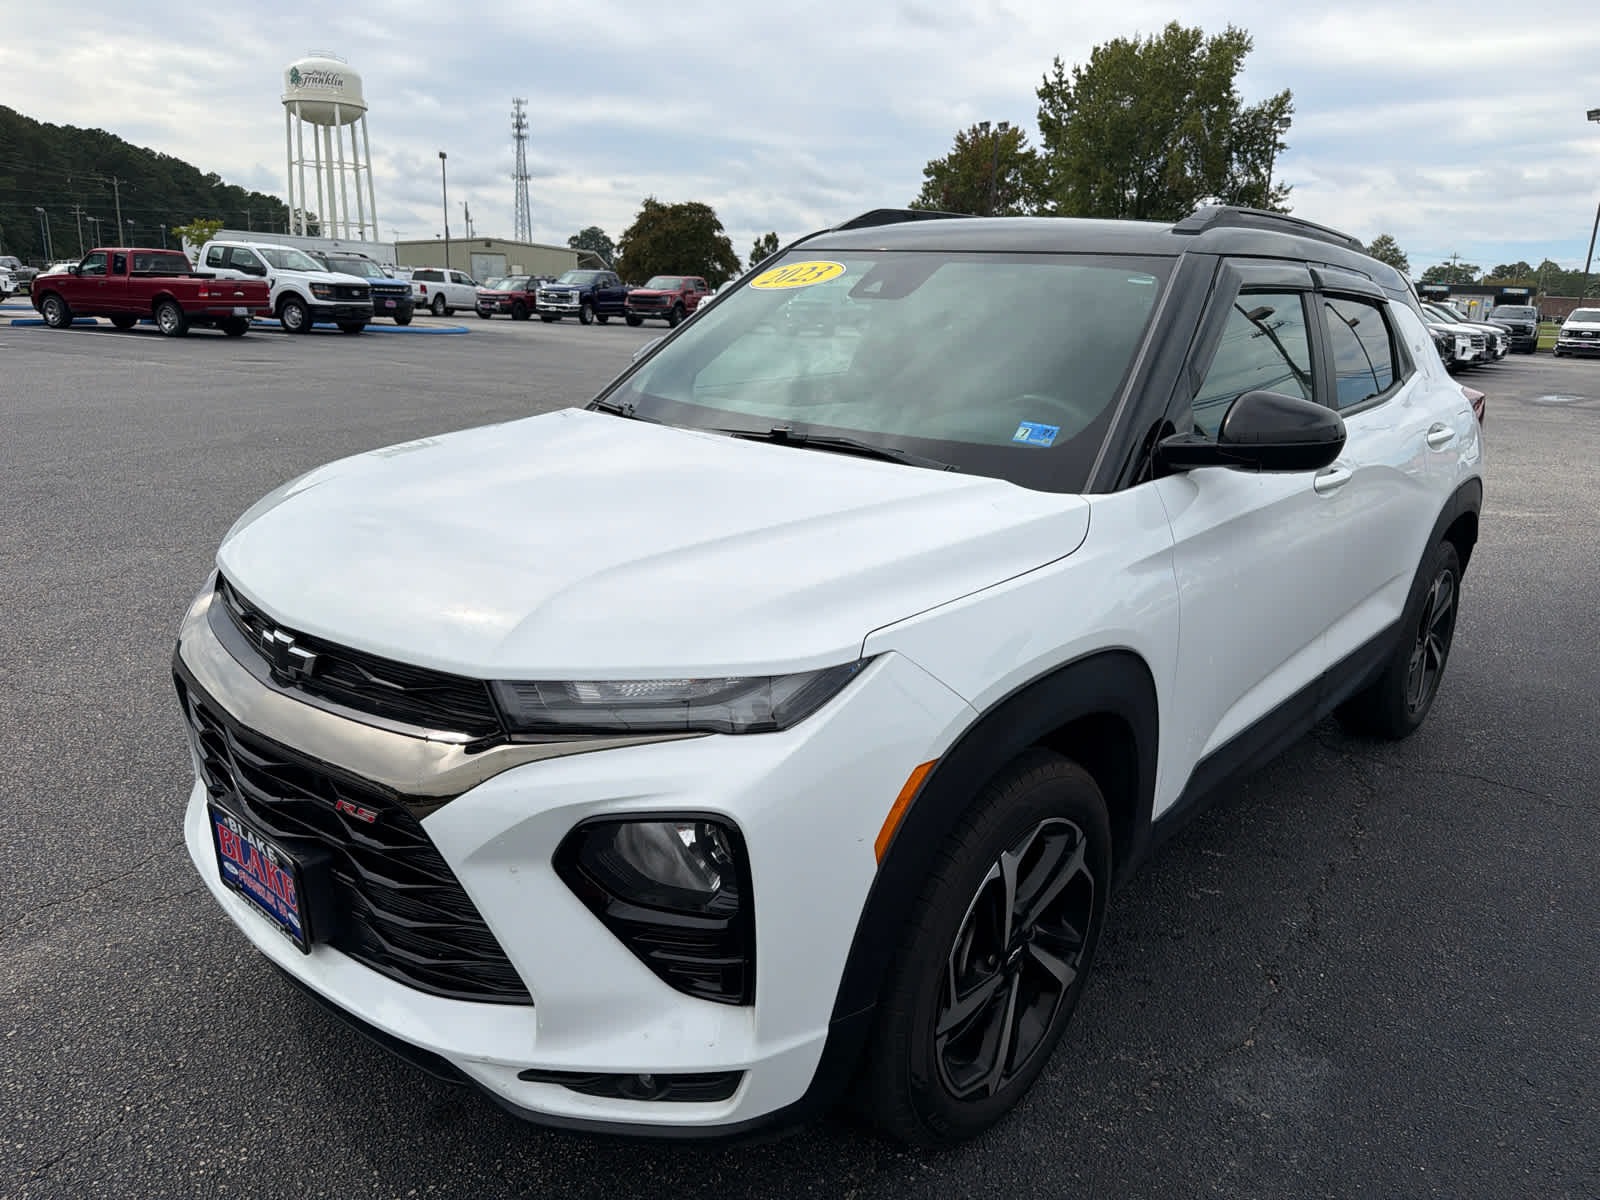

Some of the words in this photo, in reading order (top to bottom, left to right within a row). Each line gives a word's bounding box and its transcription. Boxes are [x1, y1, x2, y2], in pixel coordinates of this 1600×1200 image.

[759, 265, 834, 284] 2023
[335, 799, 377, 823] RS
[228, 817, 278, 865] BLAKE
[216, 822, 299, 913] BLAKE
